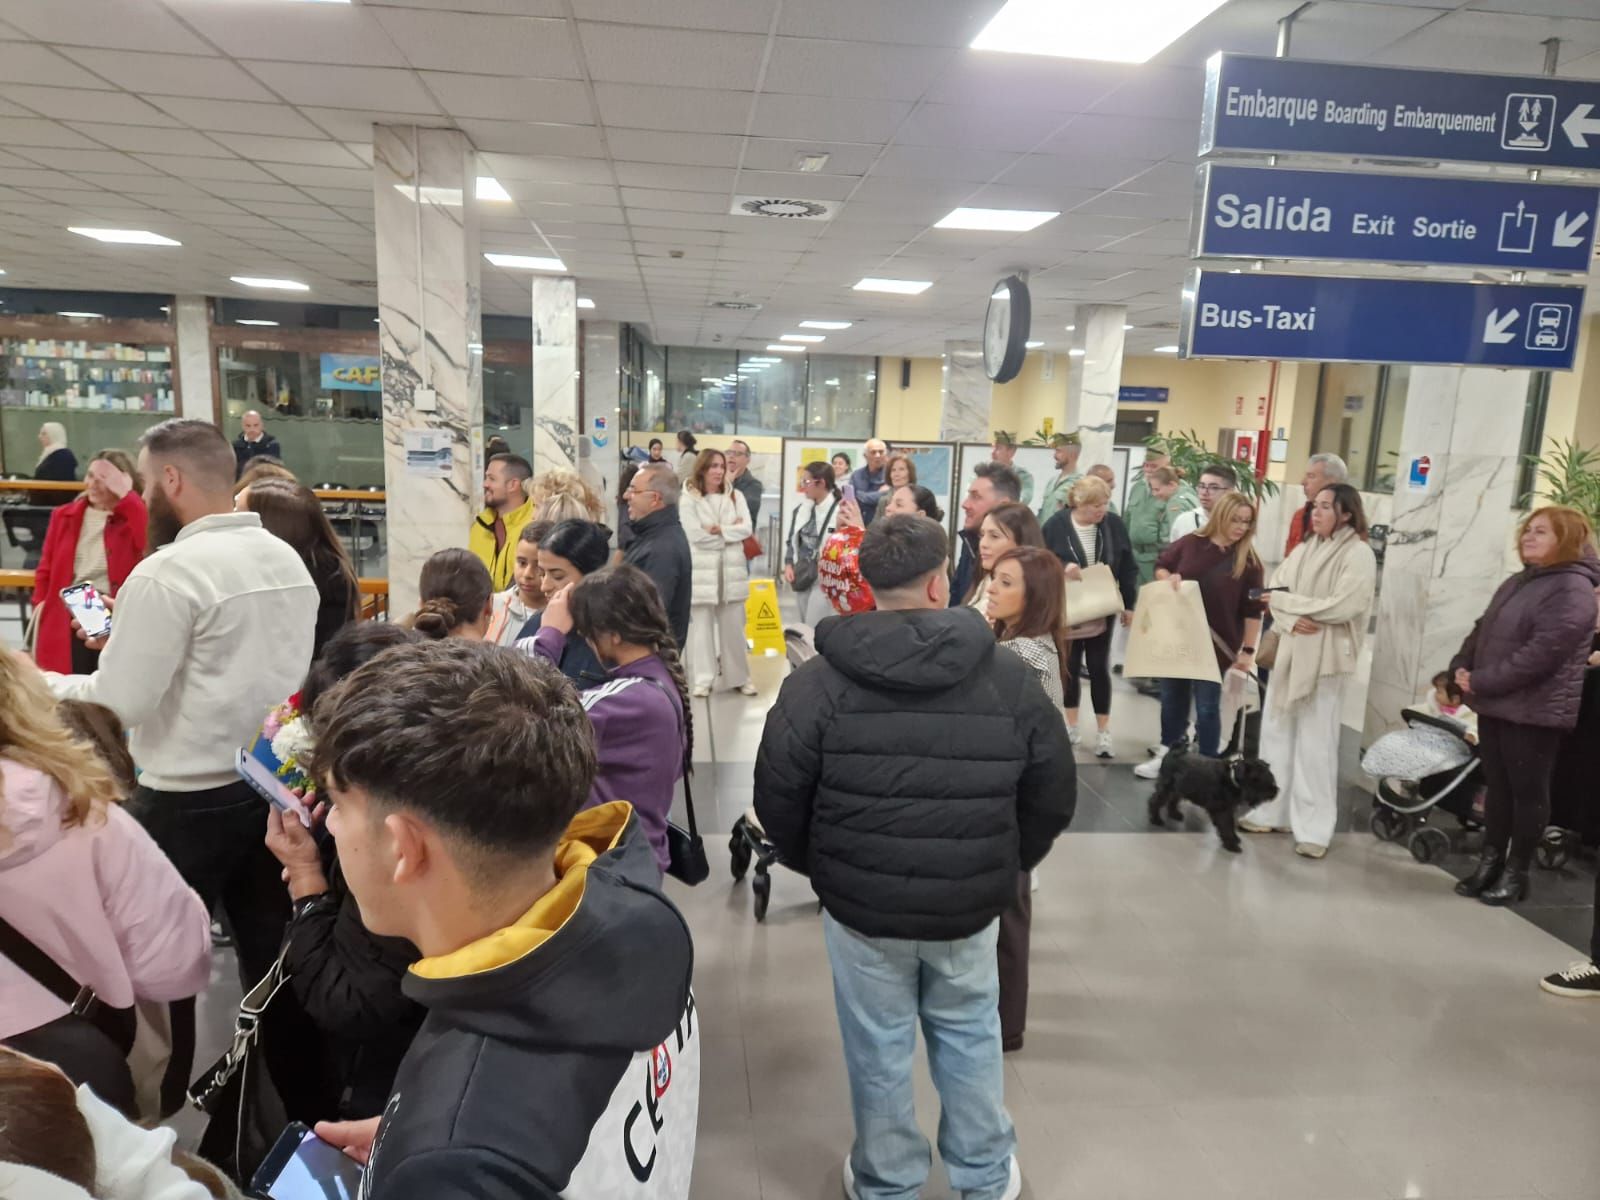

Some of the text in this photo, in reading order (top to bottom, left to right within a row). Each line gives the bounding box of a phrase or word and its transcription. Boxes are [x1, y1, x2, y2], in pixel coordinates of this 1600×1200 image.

[1226, 86, 1496, 135] Embarque Boarding Embarquement
[1215, 194, 1477, 239] Salida Exit Sortie
[1200, 303, 1316, 330] Bus-Taxi
